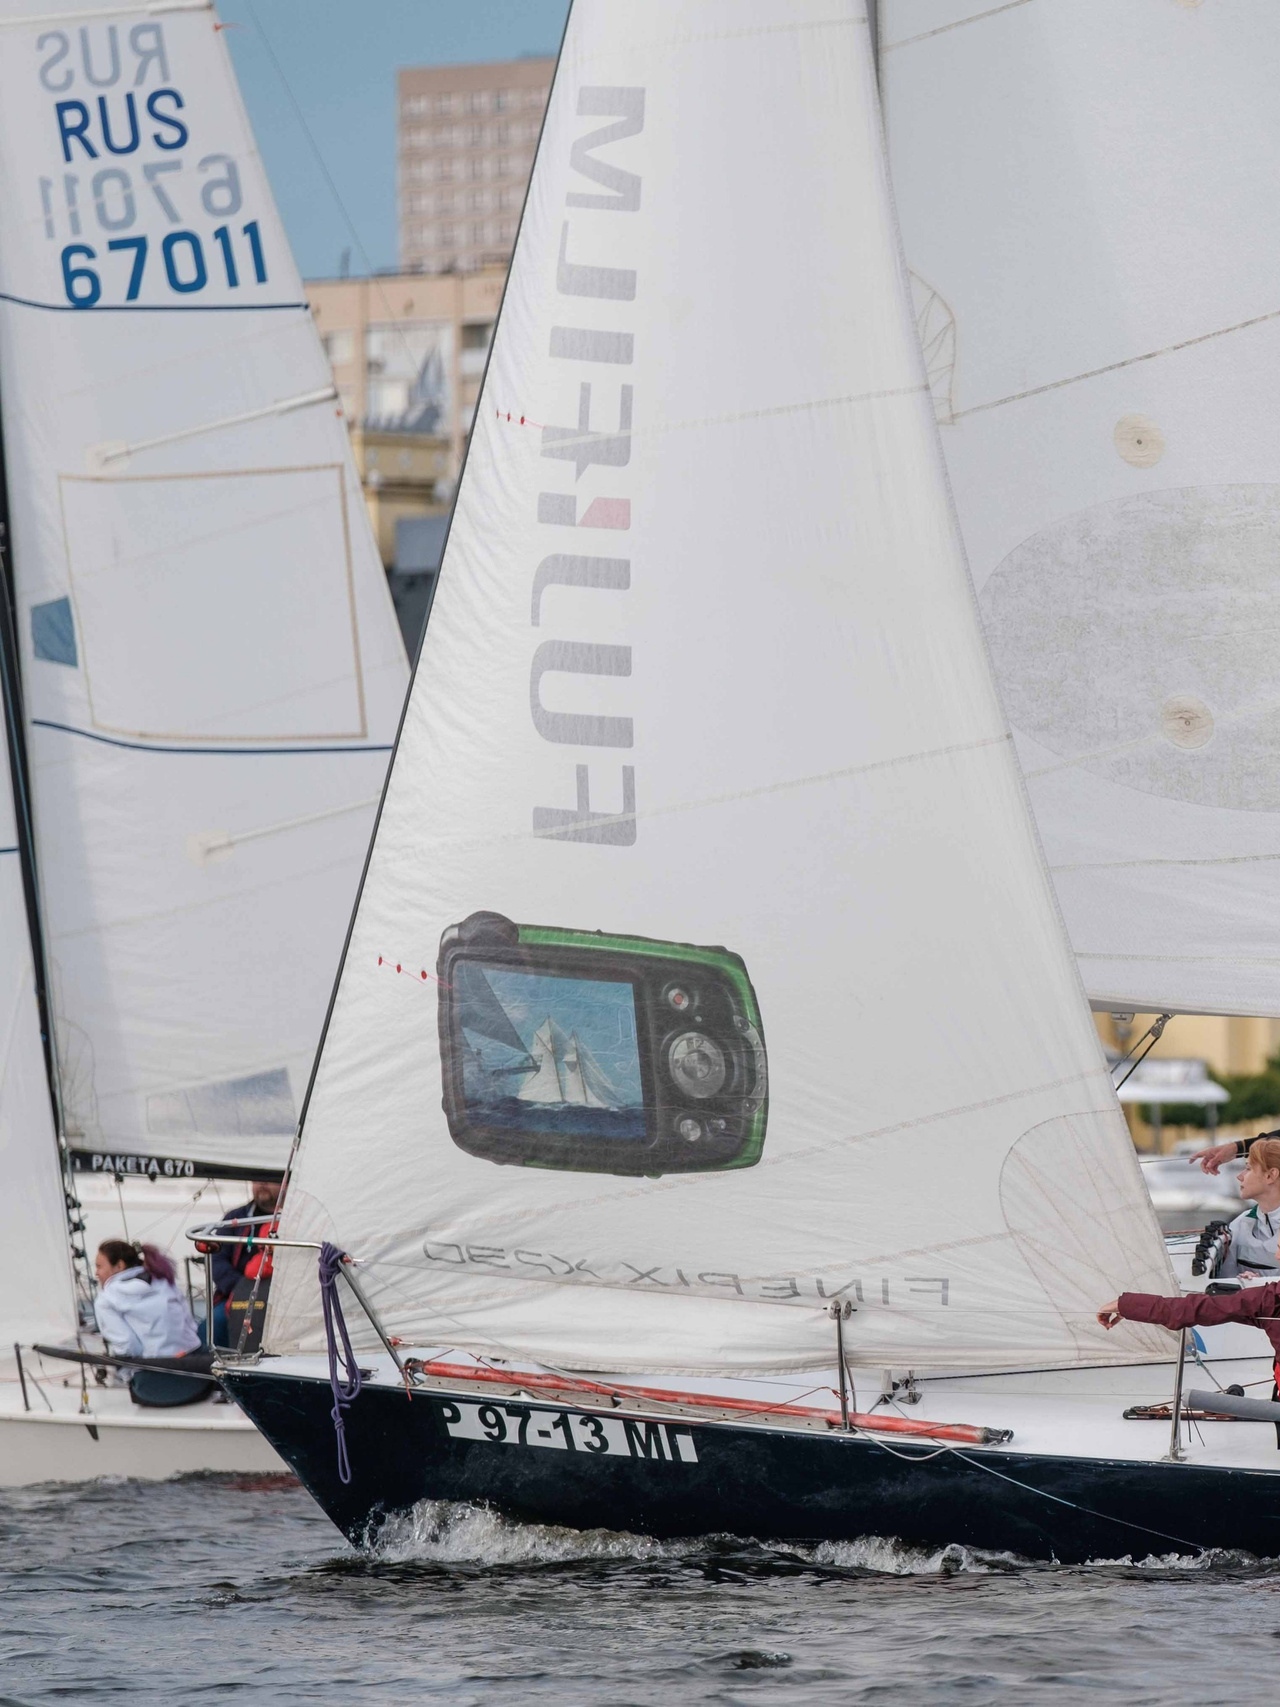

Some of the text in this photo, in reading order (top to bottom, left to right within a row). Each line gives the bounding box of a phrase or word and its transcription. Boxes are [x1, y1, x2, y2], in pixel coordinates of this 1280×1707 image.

[55, 88, 190, 162] RUS
[60, 220, 268, 309] 67011
[164, 1159, 195, 1178] 670
[477, 1404, 610, 1455] 97-13
